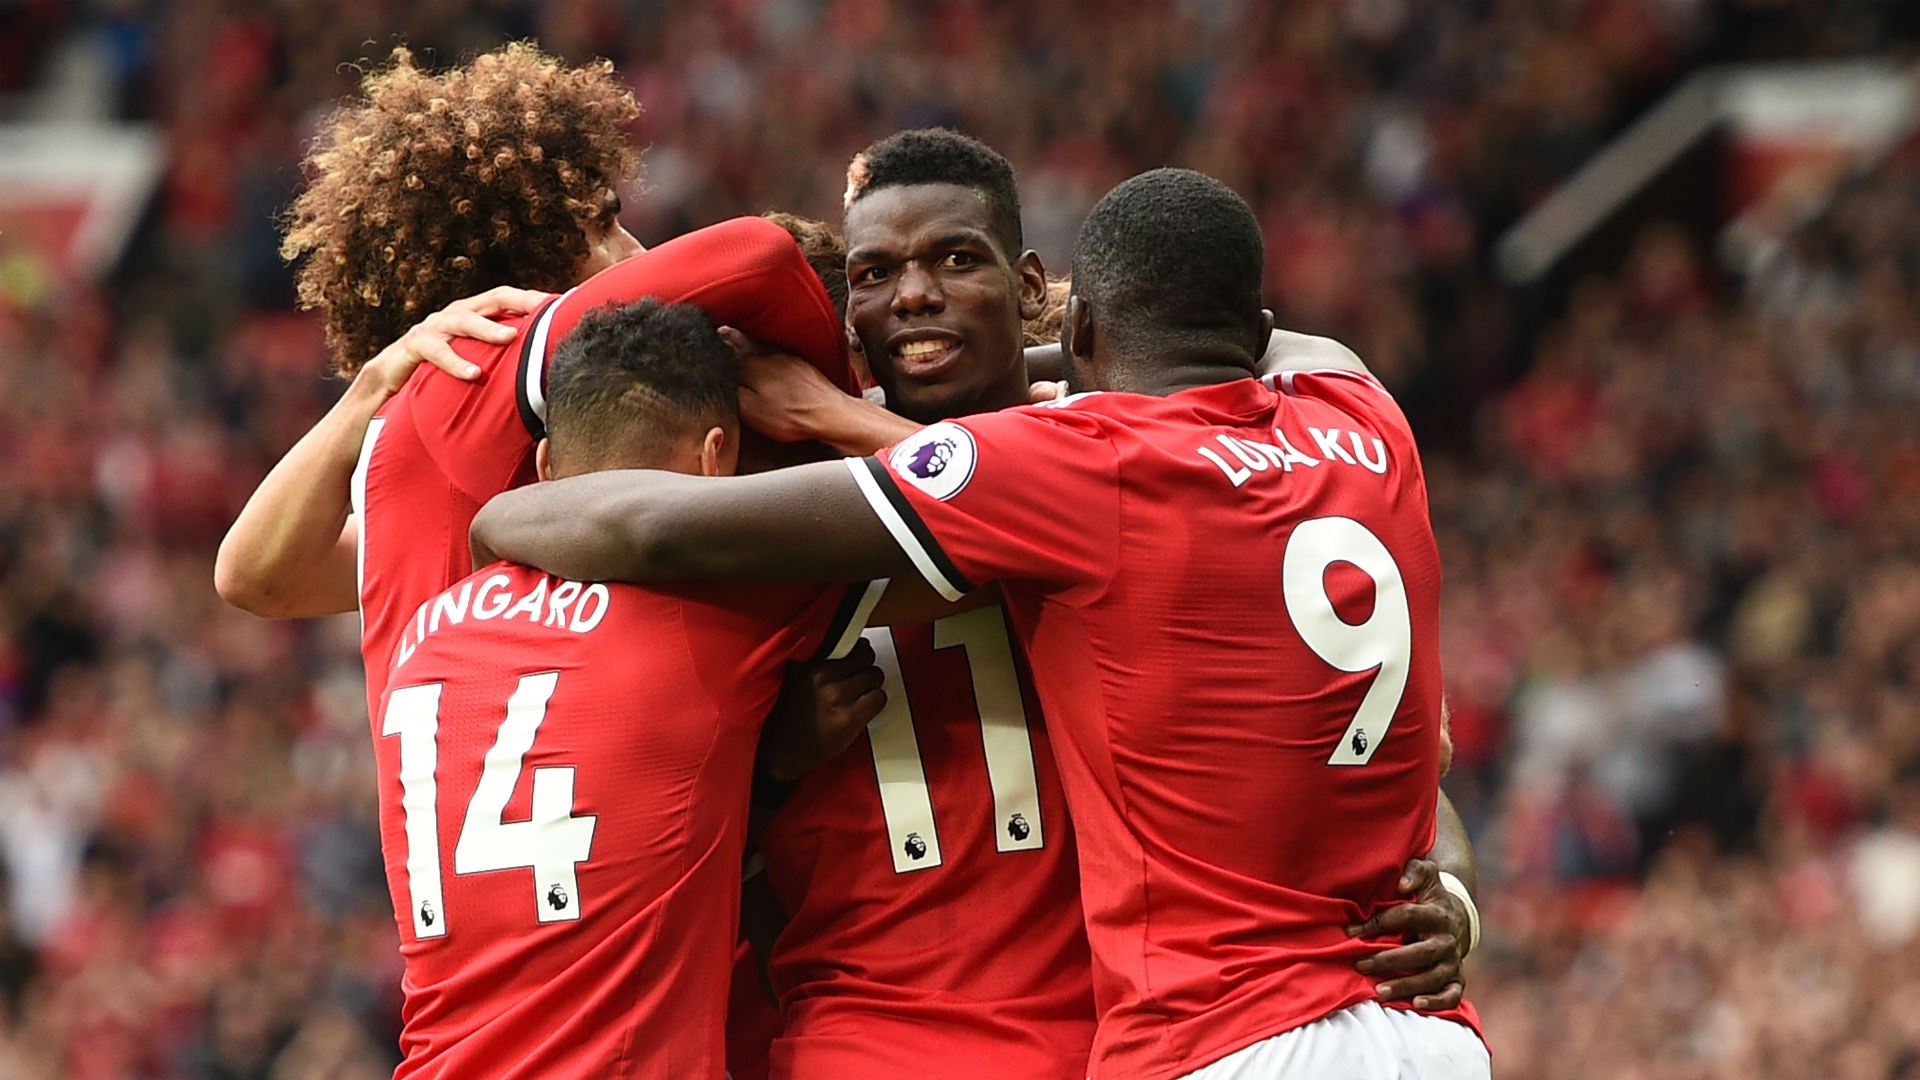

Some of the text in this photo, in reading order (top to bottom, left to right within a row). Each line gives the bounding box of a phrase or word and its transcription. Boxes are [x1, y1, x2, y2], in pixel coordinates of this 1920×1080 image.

[397, 573, 609, 668] LINGARD
[861, 604, 1044, 874] 11
[1282, 515, 1411, 766] 9
[381, 670, 598, 939] 14
